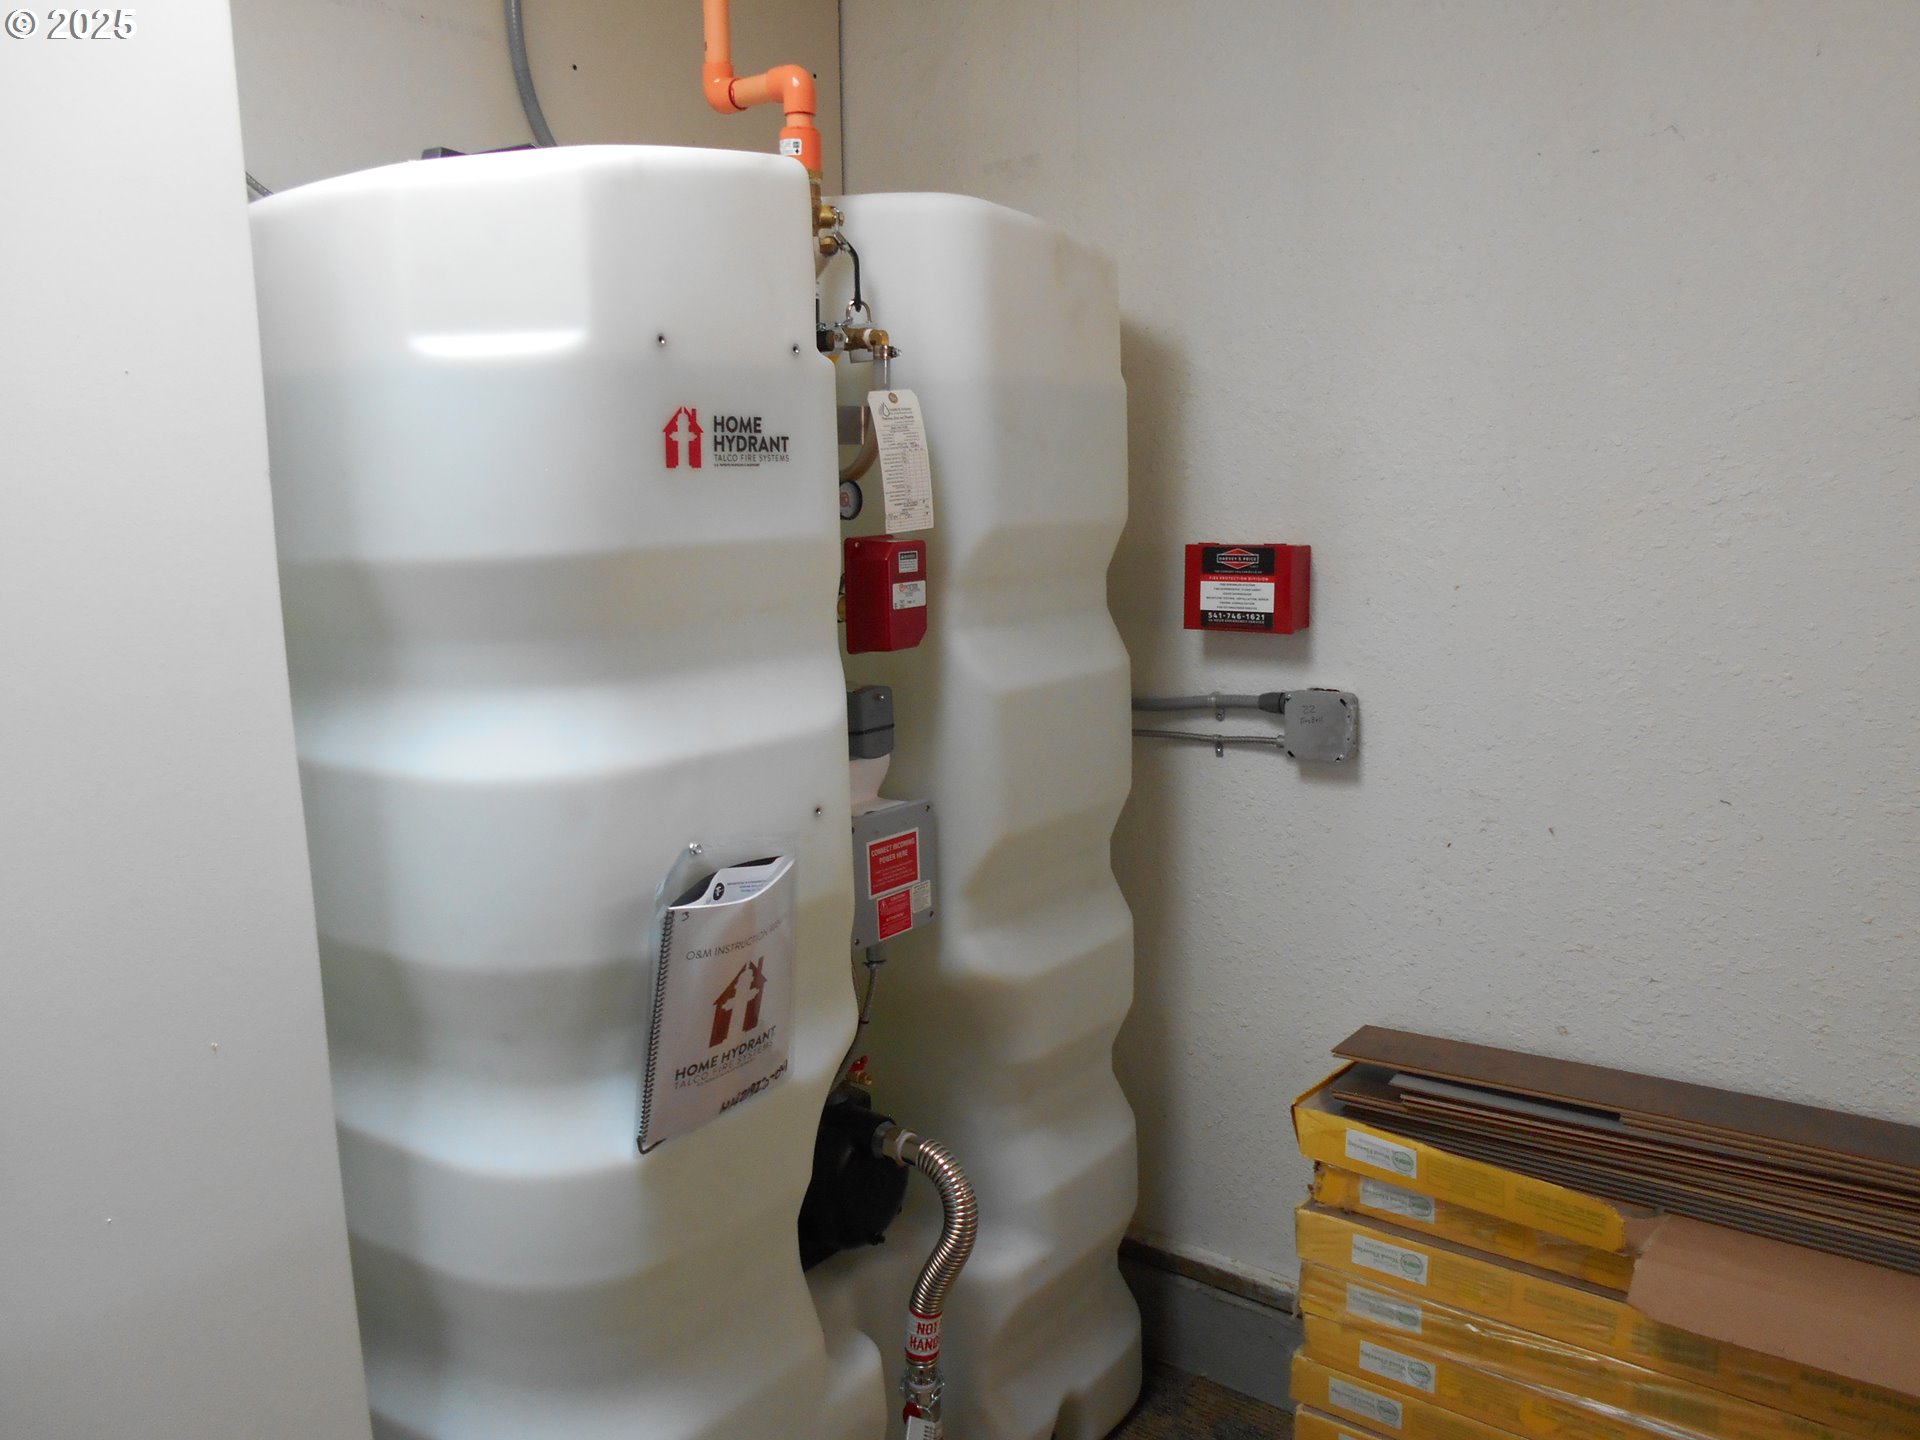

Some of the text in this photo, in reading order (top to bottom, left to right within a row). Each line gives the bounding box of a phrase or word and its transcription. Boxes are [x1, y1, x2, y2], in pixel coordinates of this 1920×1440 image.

[714, 415, 763, 434] HOME
[713, 435, 790, 453] HYDRANT
[714, 454, 790, 462] TALCO FIRE SYSTEMS
[1208, 612, 1265, 621] 541-746-1621
[686, 948, 712, 960] O&M
[675, 1055, 719, 1082] HOME
[721, 1025, 777, 1063] HYDRANT
[675, 1072, 709, 1090] TALCO
